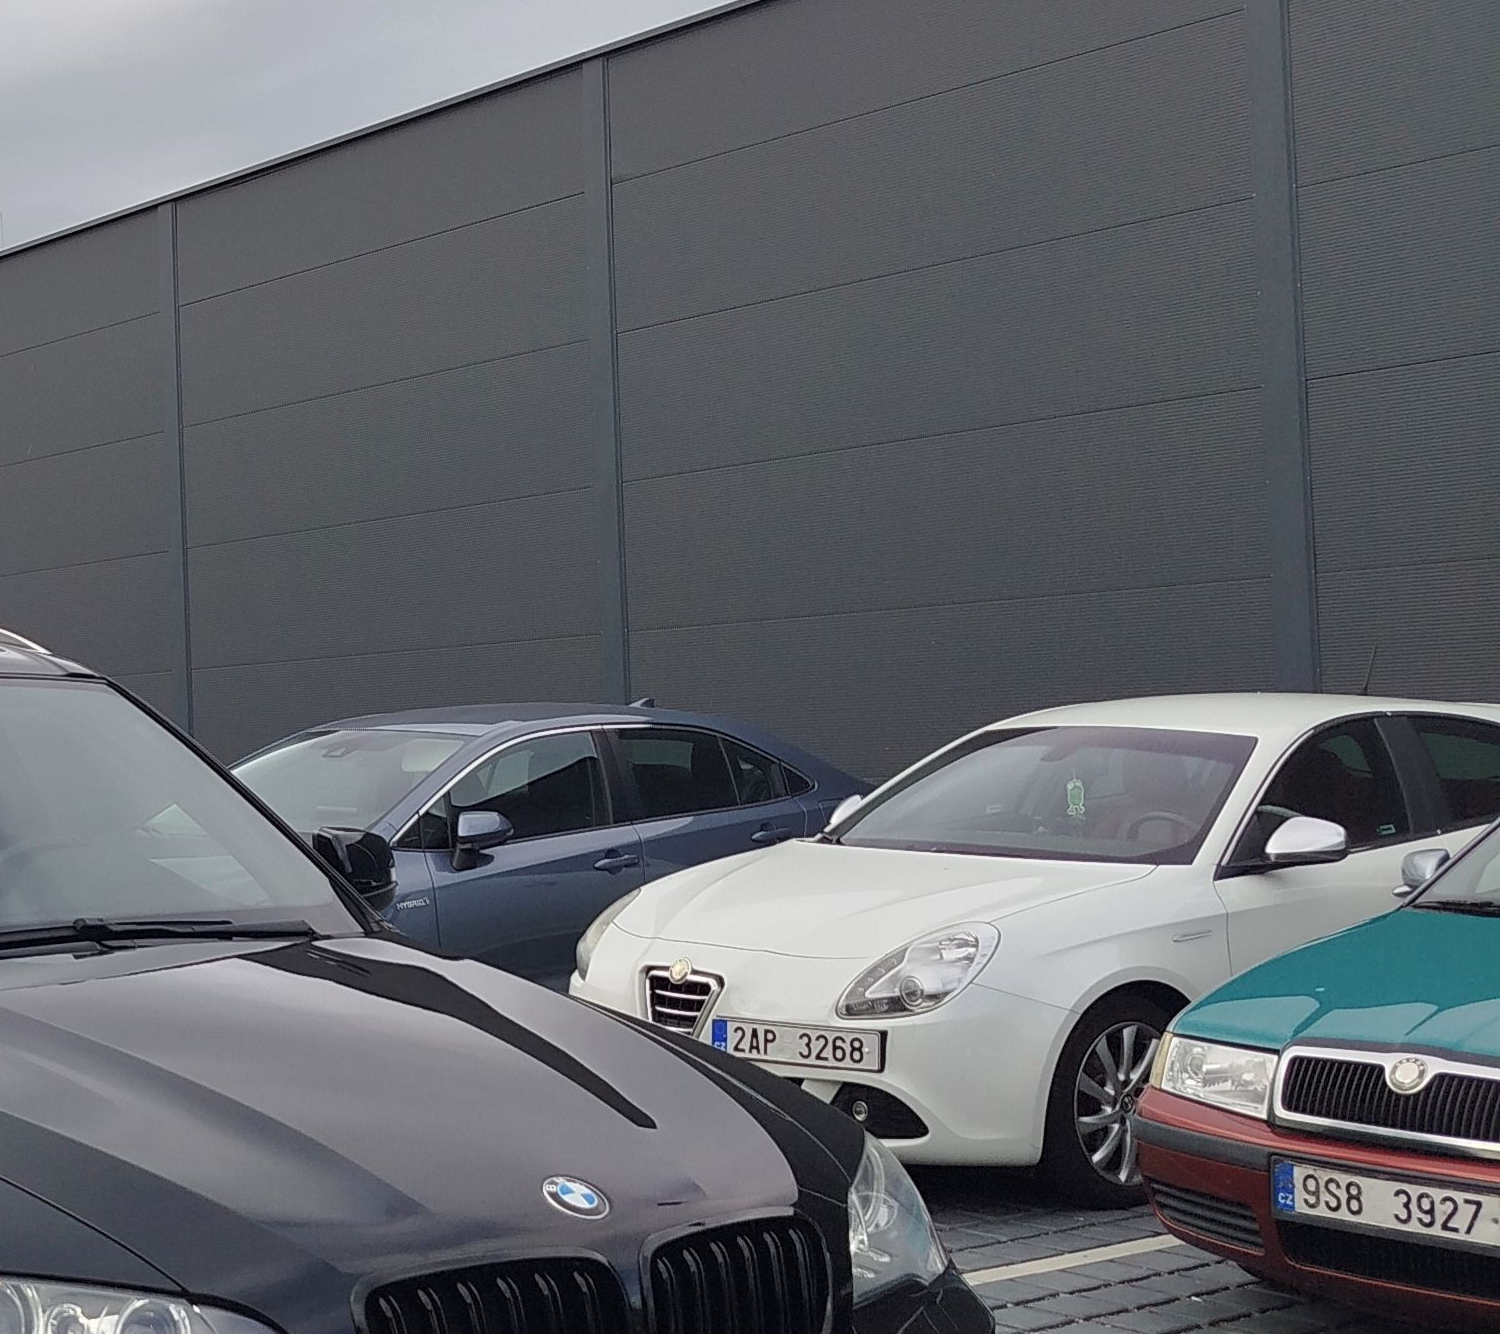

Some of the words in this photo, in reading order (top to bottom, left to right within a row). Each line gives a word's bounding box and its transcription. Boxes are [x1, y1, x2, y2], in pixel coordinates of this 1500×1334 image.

[733, 1026, 777, 1056] 2AP
[798, 1032, 864, 1064] 3268
[1277, 1192, 1294, 1206] CZ
[1302, 1173, 1364, 1216] 9S8
[1393, 1188, 1483, 1235] 3927
